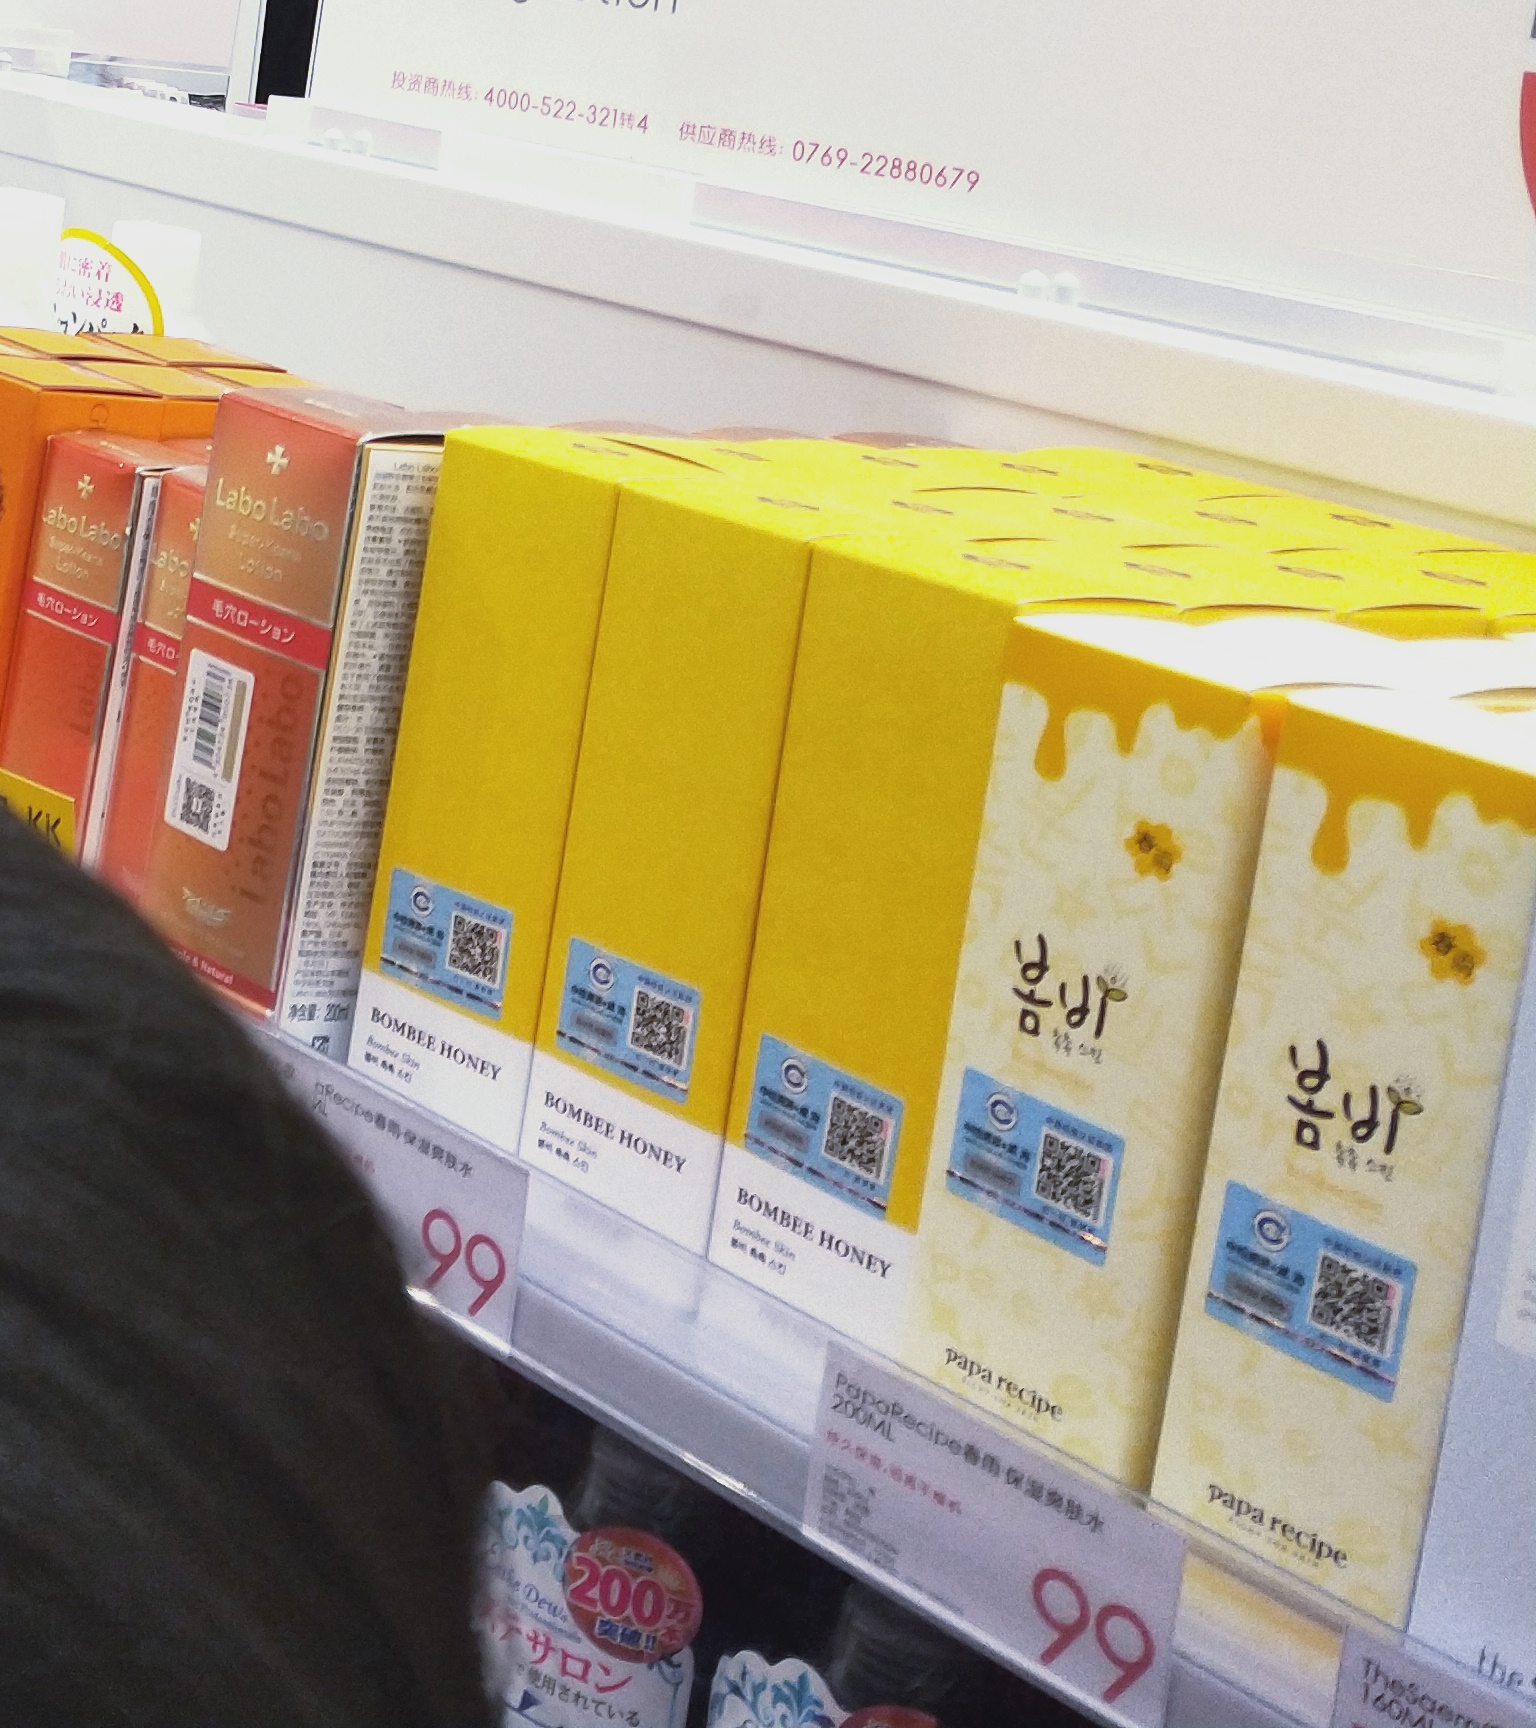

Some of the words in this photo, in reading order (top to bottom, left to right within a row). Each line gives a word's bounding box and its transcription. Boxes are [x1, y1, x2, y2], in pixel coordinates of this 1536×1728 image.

[792, 138, 980, 194] 0769-22880679
[216, 477, 266, 521] Labo
[269, 497, 328, 541] Labo
[152, 550, 189, 577] abo
[37, 592, 99, 626] 毛穴ローション
[212, 598, 295, 643] 毛穴ローション
[371, 1006, 437, 1052] BOMBEE
[439, 1040, 502, 1081] HONEY
[543, 1090, 616, 1141] BOMBEE
[618, 1130, 687, 1175] HONEY
[422, 1208, 507, 1317] 99
[737, 1187, 815, 1242] BOMBEE
[818, 1229, 892, 1279] HONEY
[831, 1393, 896, 1444] 200ML
[945, 1348, 993, 1384] papa
[997, 1375, 1063, 1422] recipe
[1208, 1482, 1267, 1530] papa
[1269, 1509, 1349, 1571] recipe
[568, 1553, 665, 1627] 200
[1031, 1567, 1156, 1703] 99
